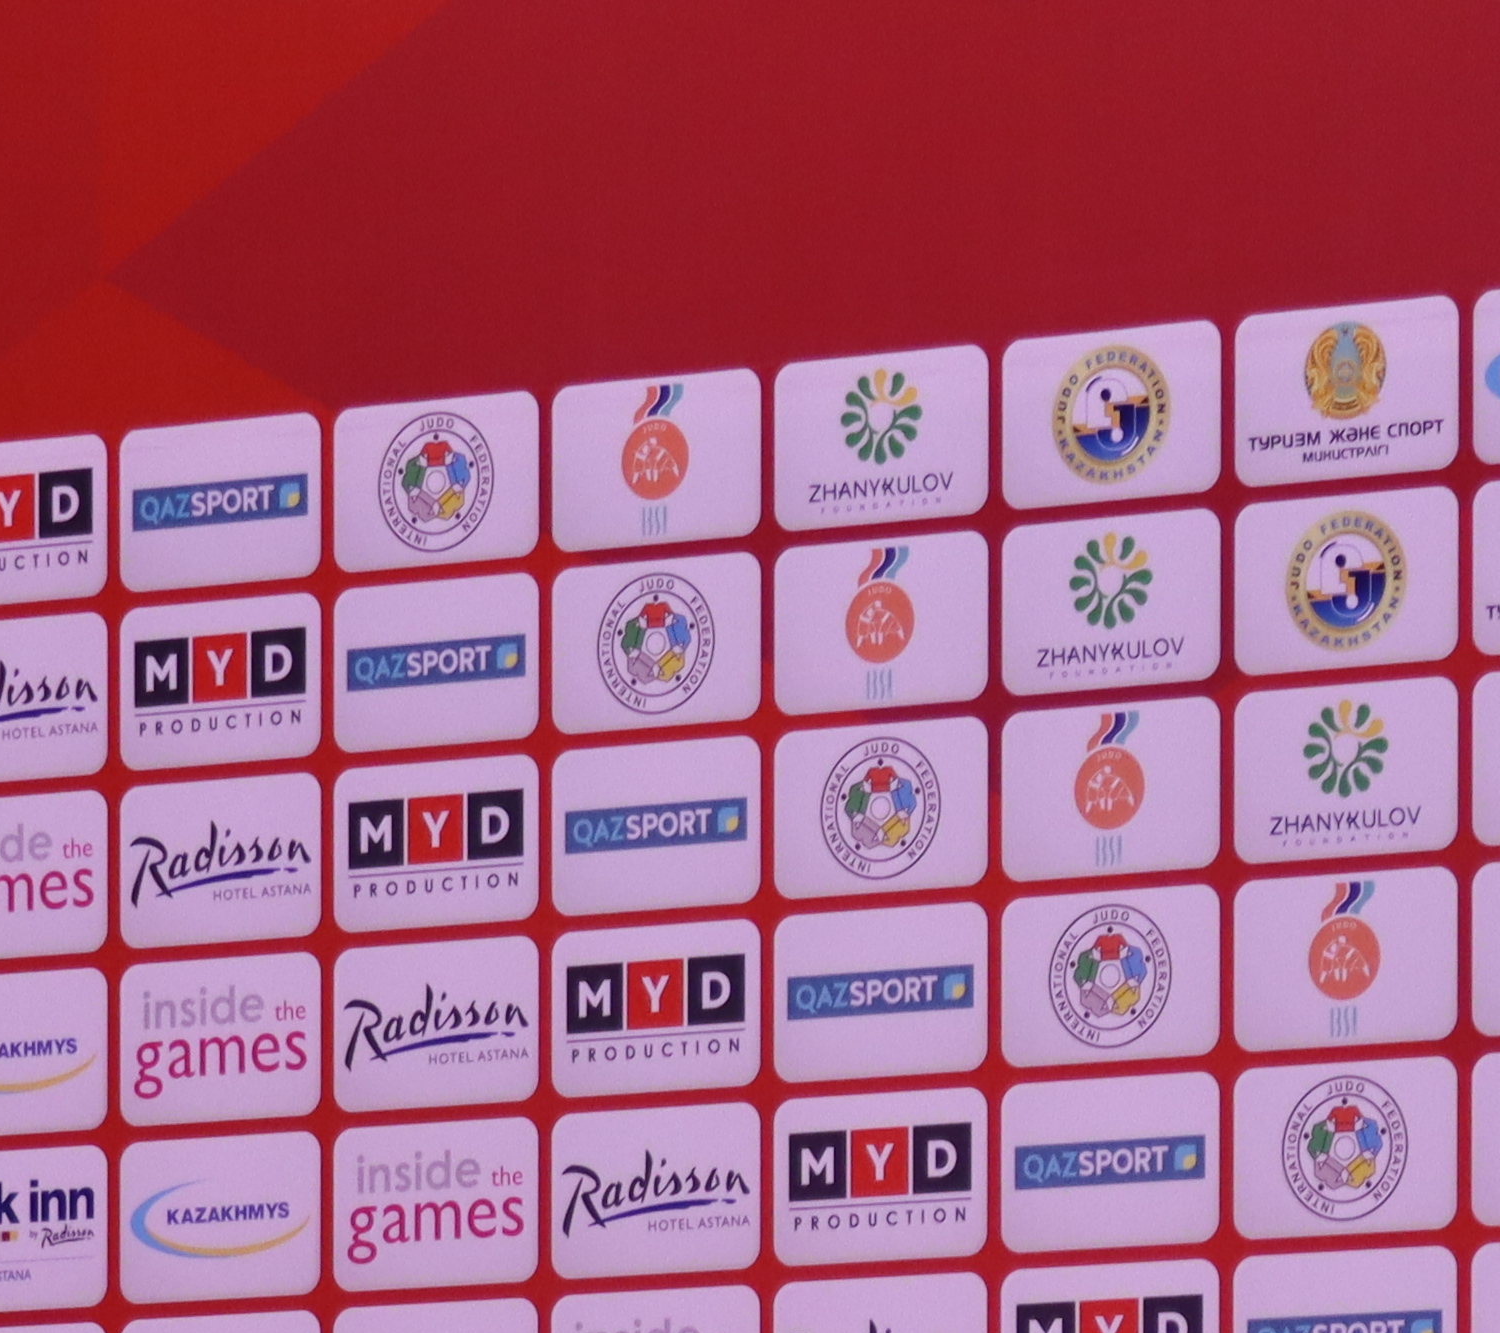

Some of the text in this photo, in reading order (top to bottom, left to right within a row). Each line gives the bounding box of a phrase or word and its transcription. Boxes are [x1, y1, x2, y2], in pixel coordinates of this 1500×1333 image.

[140, 483, 275, 523] QAZSPORT
[808, 472, 953, 504] ZHANYKULOV
[145, 640, 292, 693] MYD
[354, 644, 492, 682] QAZSPORT
[1036, 637, 1184, 668] ZHANYKULOV
[1, 722, 98, 740] HOTEL ASTANA
[139, 709, 301, 737] PRODUCTION
[360, 803, 510, 854] MYD
[573, 807, 713, 845] QAZSPORT
[62, 838, 93, 859] the
[352, 872, 519, 899] PRODUCTION
[801, 1135, 957, 1188] MYD
[1023, 1144, 1169, 1181] QAZSPORT
[29, 1179, 95, 1223] inn
[166, 1201, 290, 1225] KAZAKHMYS
[793, 1207, 966, 1232] PRODUCTION
